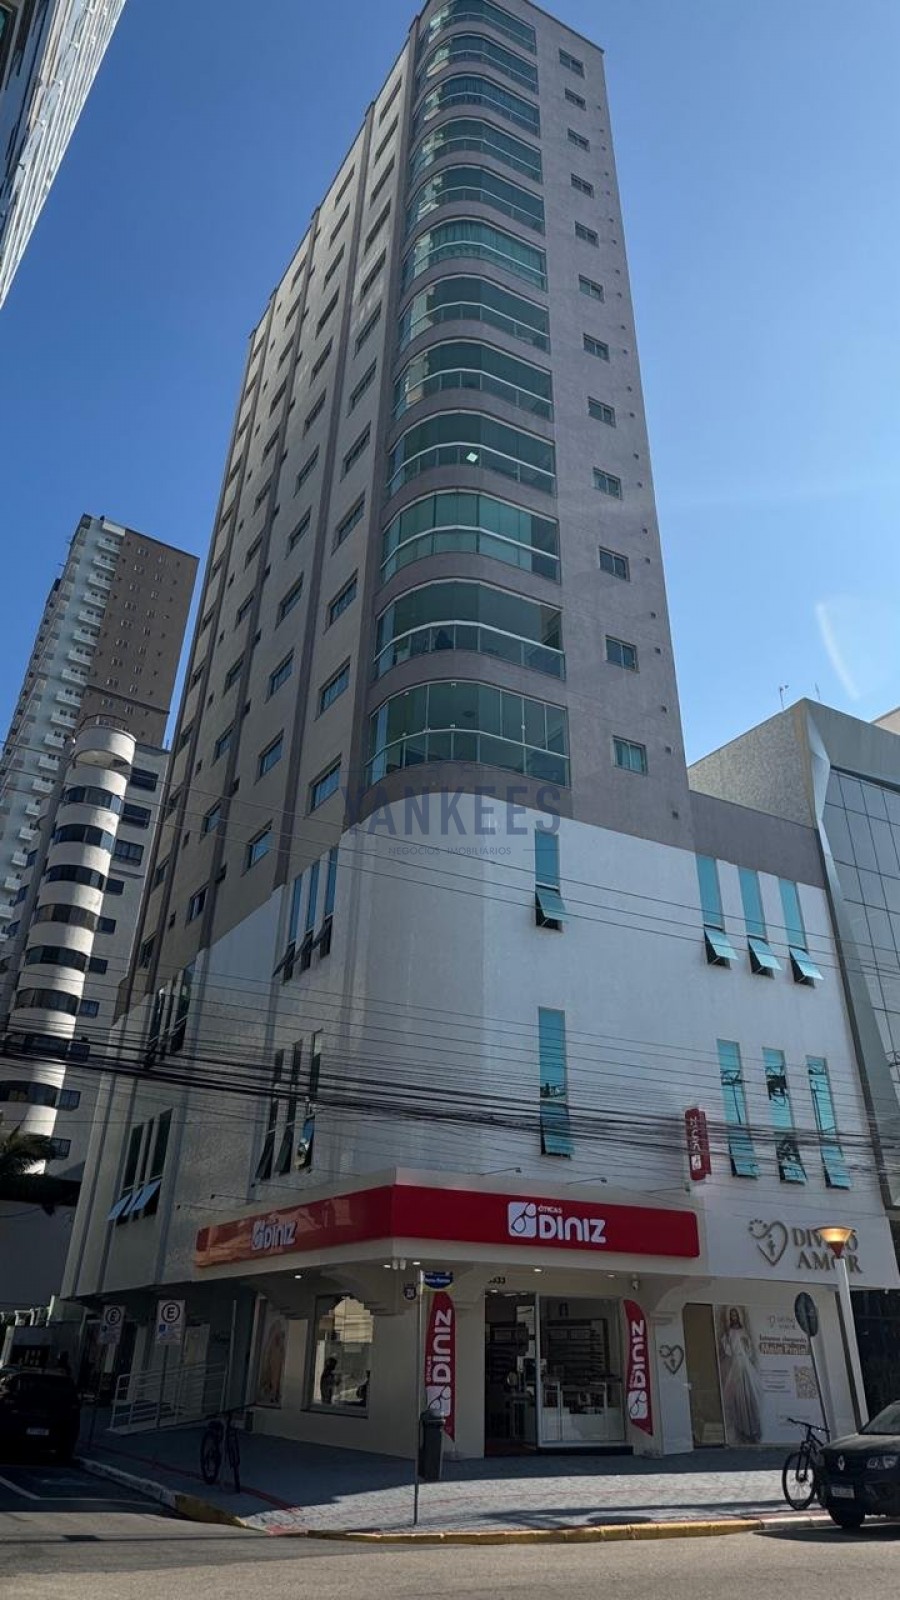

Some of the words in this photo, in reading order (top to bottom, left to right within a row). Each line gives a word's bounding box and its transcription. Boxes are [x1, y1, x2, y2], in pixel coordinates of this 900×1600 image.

[539, 1214, 606, 1244] DINIZ
[792, 1228, 859, 1252] DIVO
[167, 1307, 175, 1319] E
[432, 1309, 452, 1384] DINIZ
[631, 1319, 646, 1389] DINIZ
